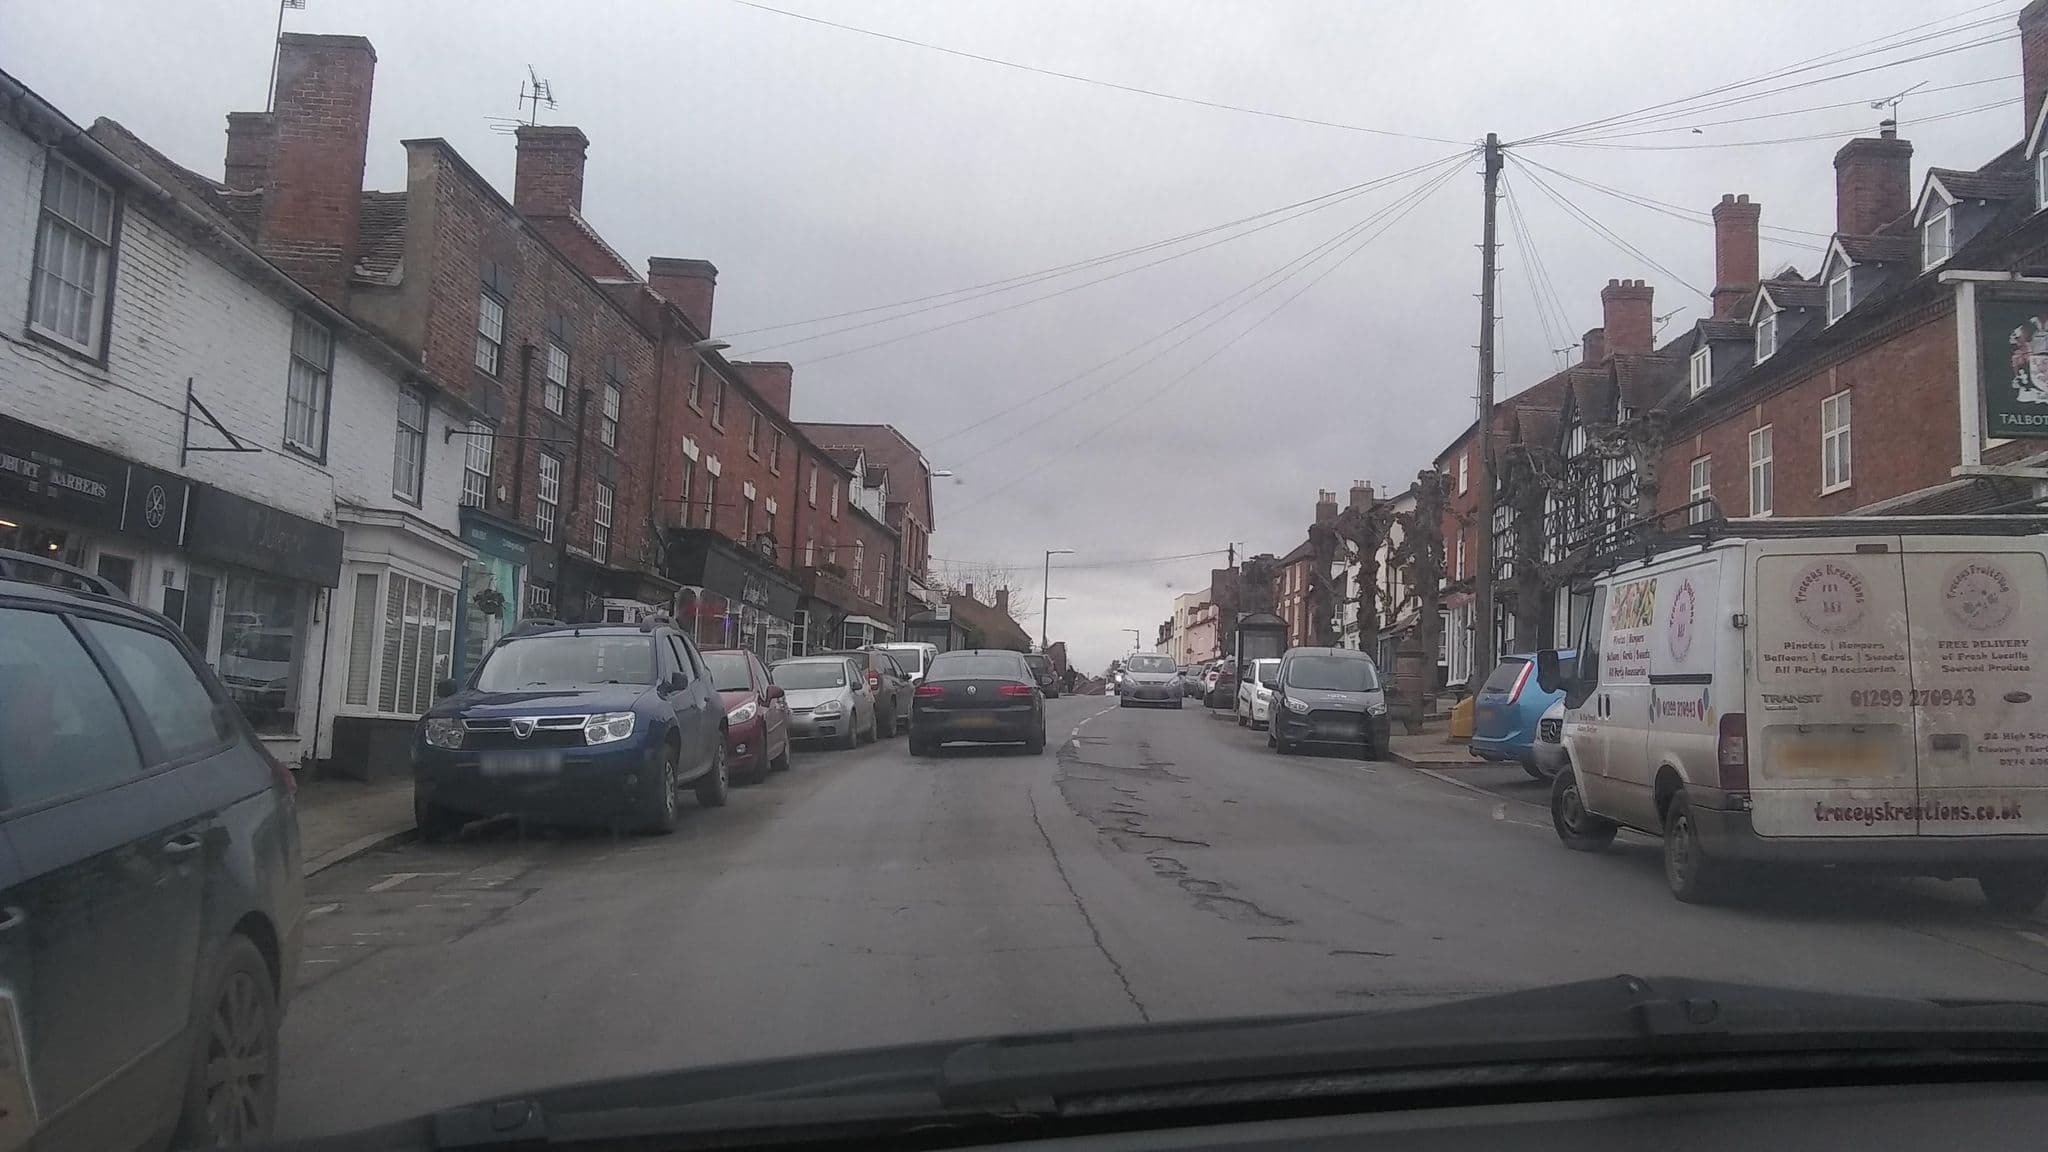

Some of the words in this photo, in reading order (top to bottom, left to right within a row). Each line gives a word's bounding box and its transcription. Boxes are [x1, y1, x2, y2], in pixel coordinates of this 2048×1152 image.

[2000, 413, 2048, 426] TALBOT
[1938, 640, 1969, 649] FREE
[1973, 639, 2030, 649] DELIVERY
[1761, 694, 1823, 704] TRANSIT
[1850, 689, 1904, 707] 01299
[1909, 688, 1977, 707] 270943
[1814, 801, 2022, 827] traceyskreations.co.uk
